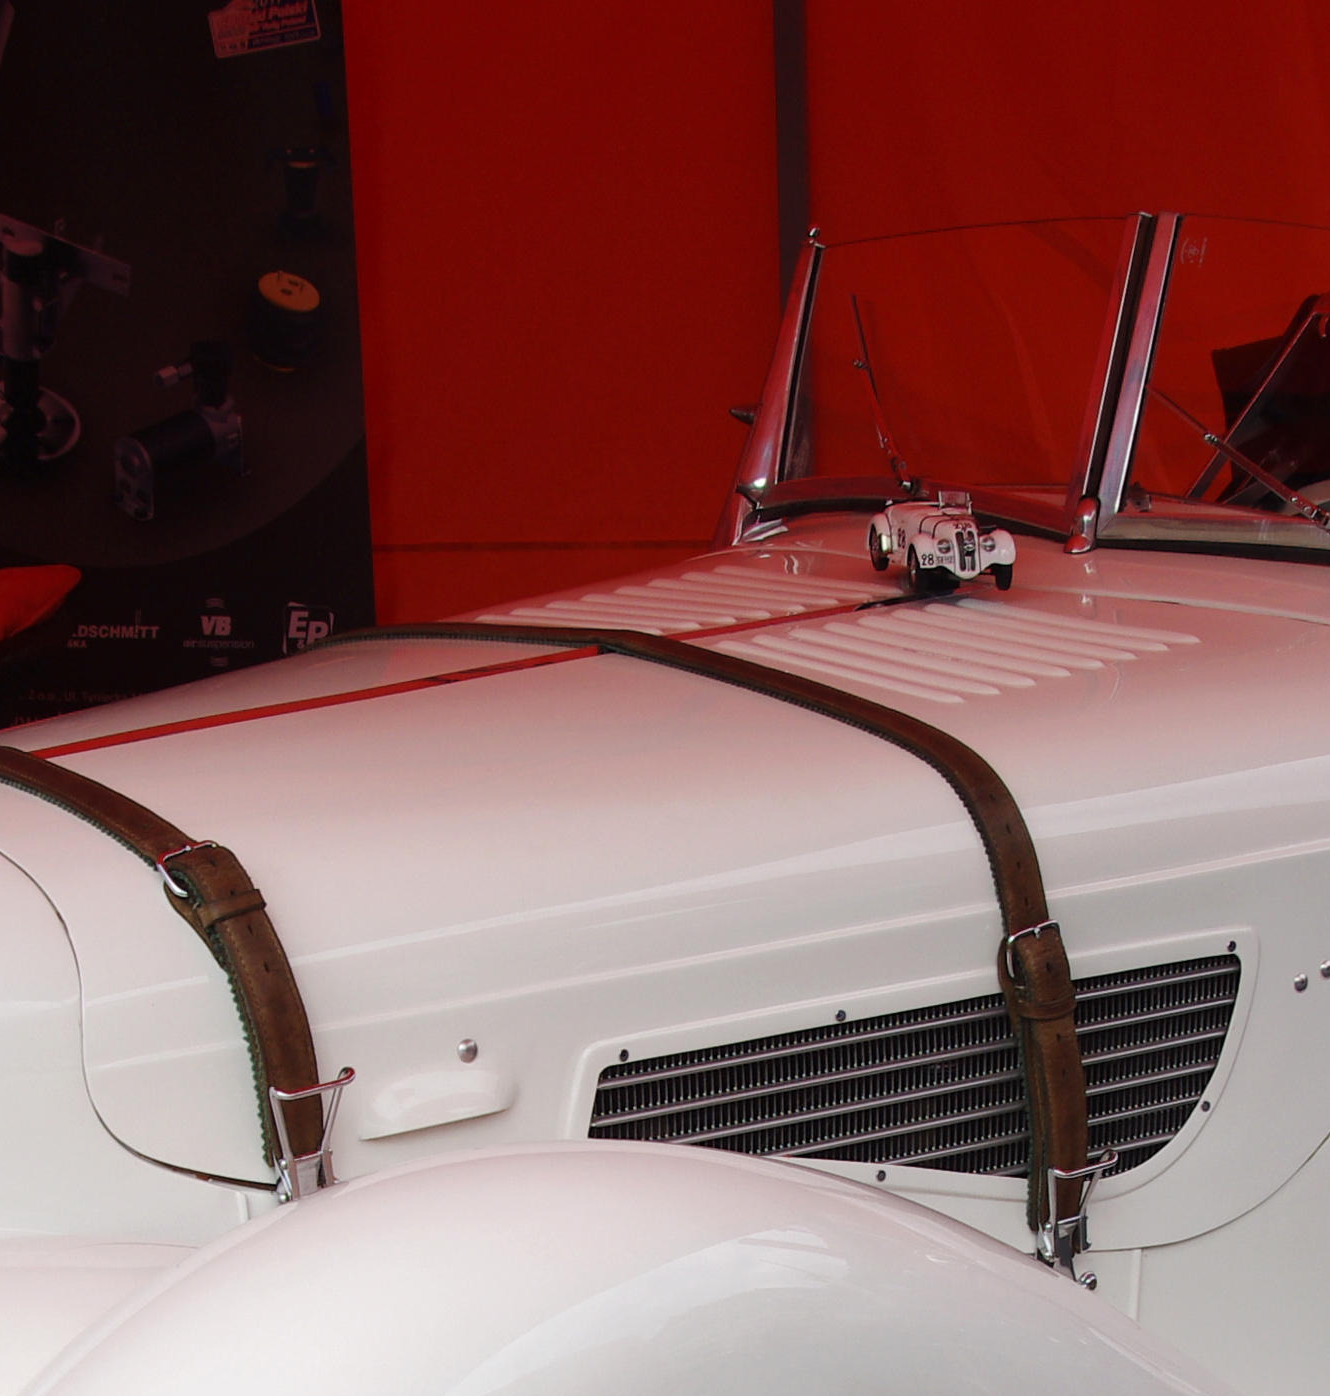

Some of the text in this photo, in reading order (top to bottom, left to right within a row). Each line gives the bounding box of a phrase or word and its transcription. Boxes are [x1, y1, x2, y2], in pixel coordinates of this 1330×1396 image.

[921, 553, 935, 566] 28
[72, 624, 160, 639] DSCHMITT
[200, 615, 232, 637] VB
[182, 638, 255, 651] airsuspension
